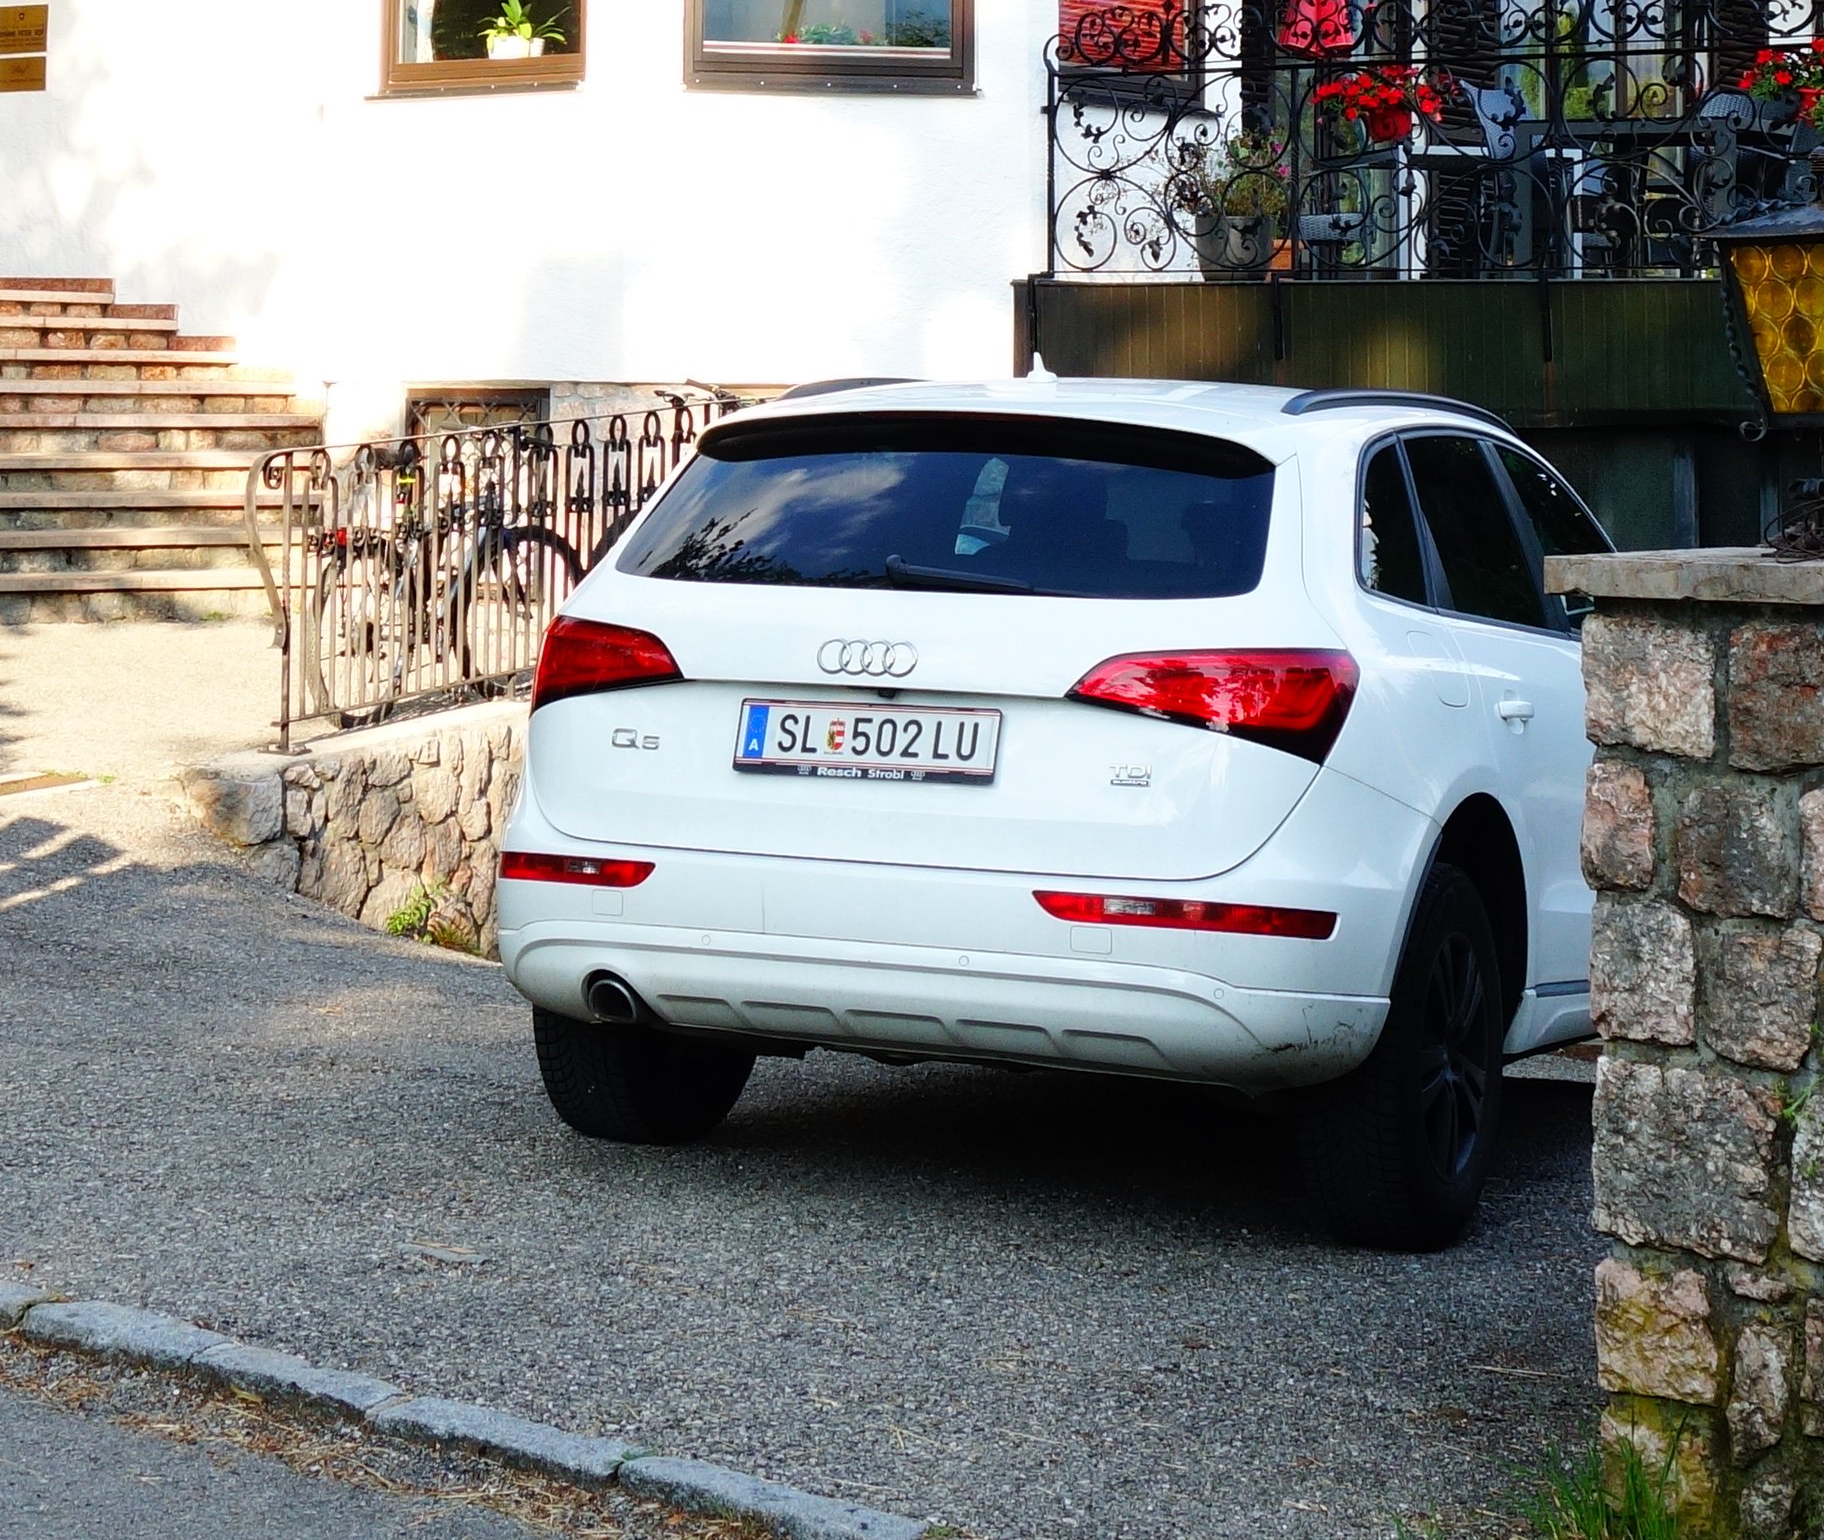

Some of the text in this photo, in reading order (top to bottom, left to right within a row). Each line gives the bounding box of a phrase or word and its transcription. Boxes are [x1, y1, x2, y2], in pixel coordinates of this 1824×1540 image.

[612, 728, 660, 750] Q5
[748, 738, 759, 751] A
[777, 714, 980, 761] SL 502 LU
[867, 768, 905, 780] Strobl
[1109, 764, 1152, 779] TDI
